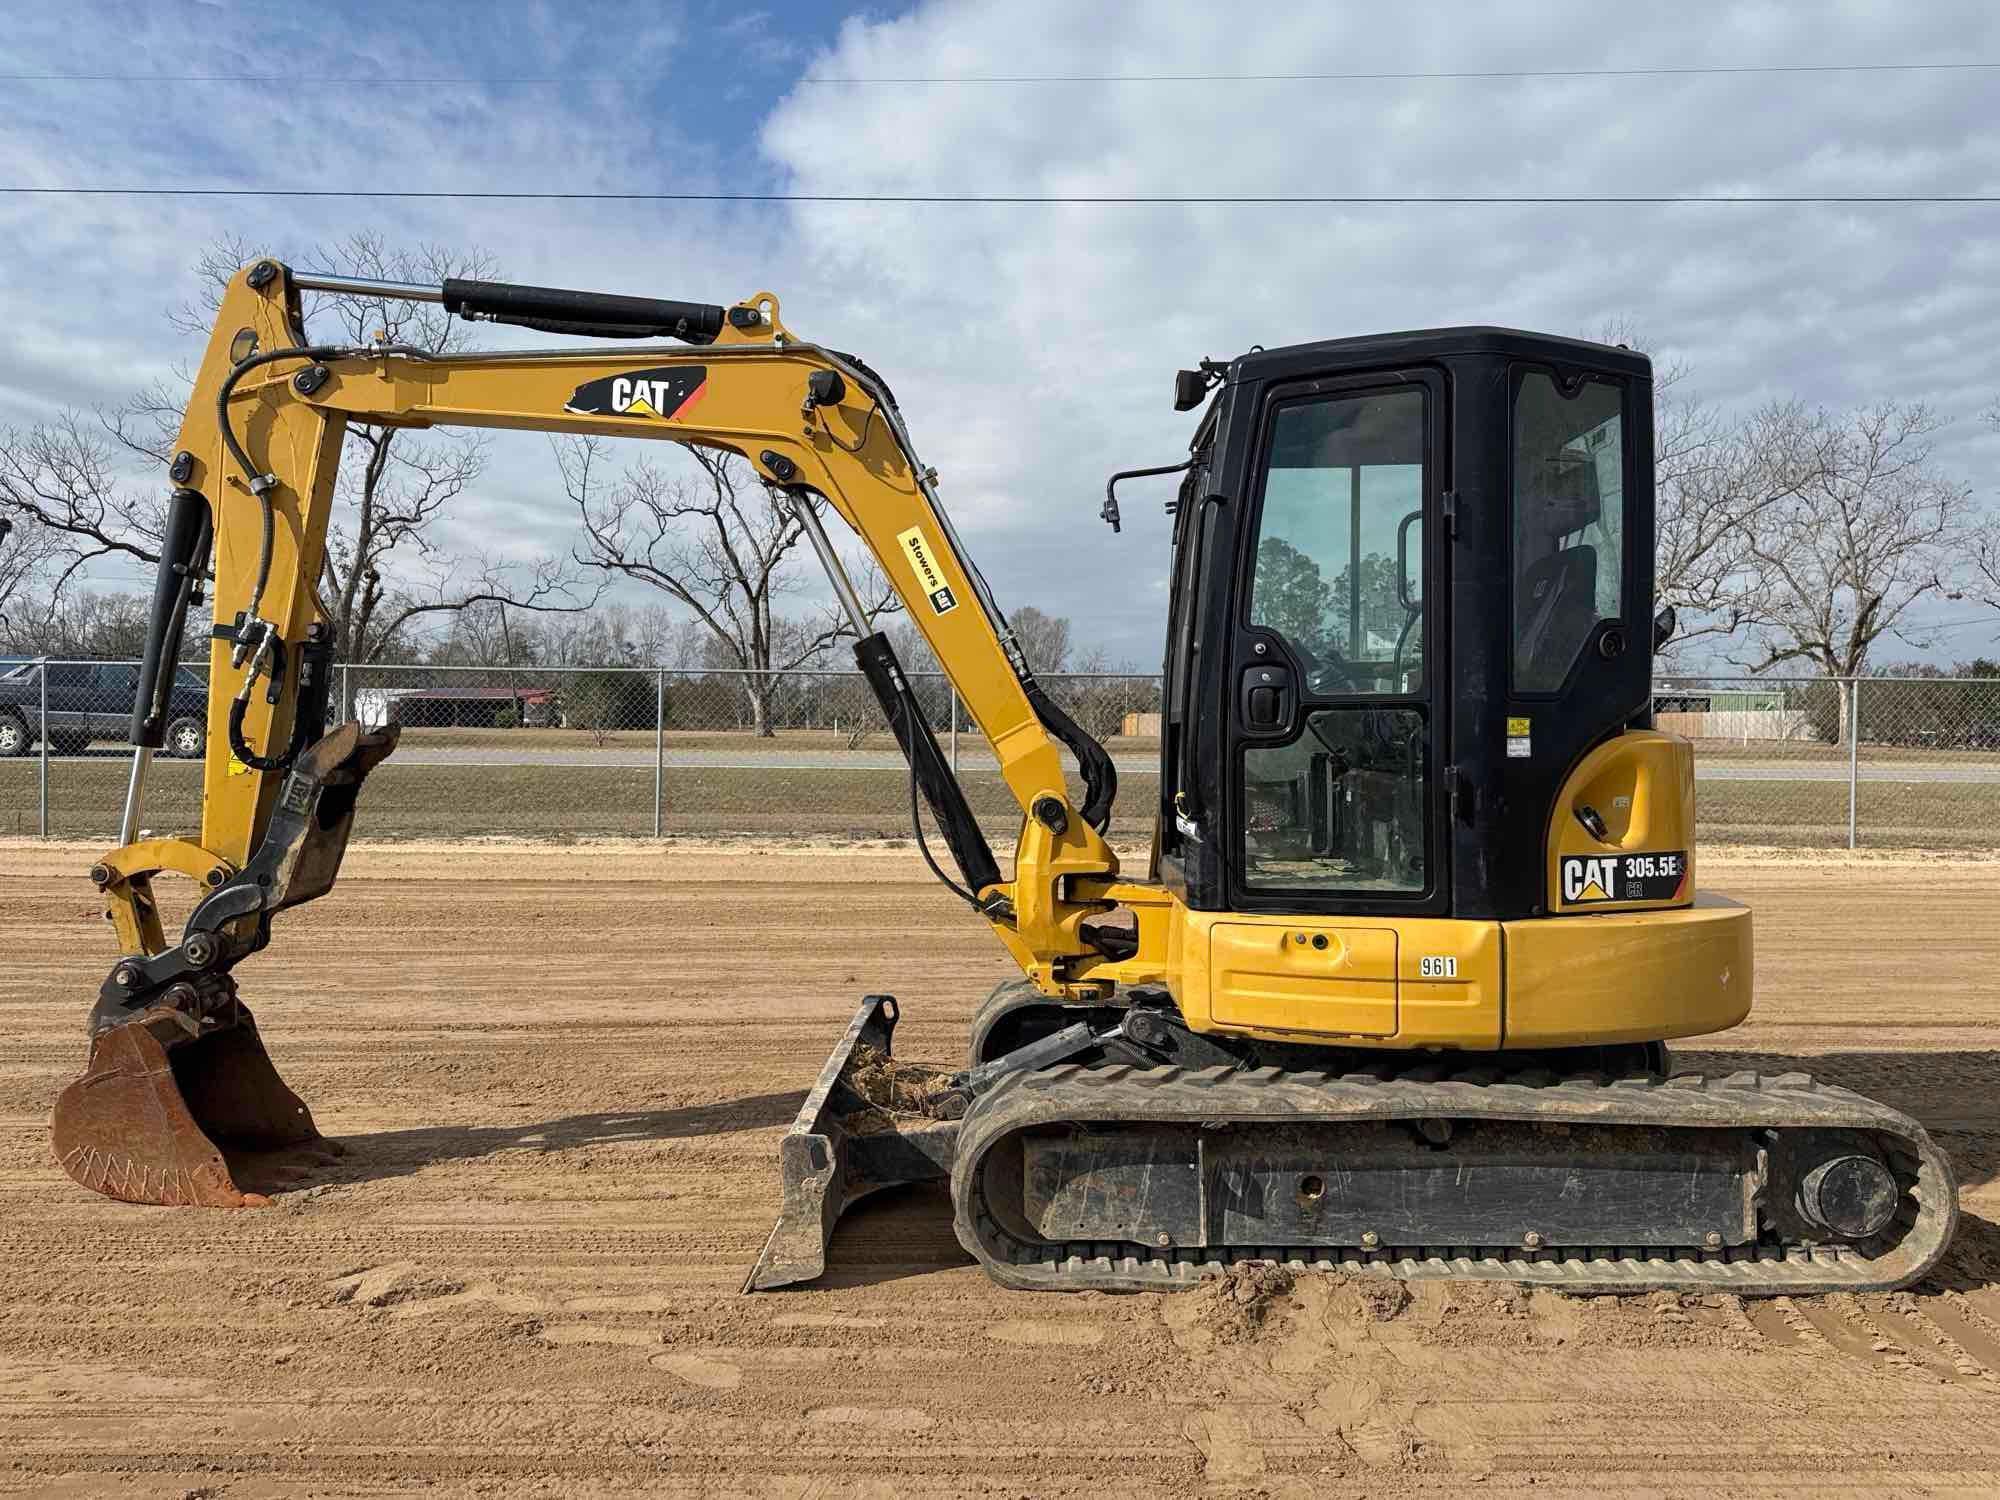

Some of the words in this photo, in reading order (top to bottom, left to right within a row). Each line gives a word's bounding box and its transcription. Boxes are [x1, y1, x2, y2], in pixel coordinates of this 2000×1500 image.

[612, 378, 669, 416] CAT
[908, 537, 938, 587] Stowers
[1564, 858, 1618, 901] CAT
[1422, 958, 1455, 976] 961
